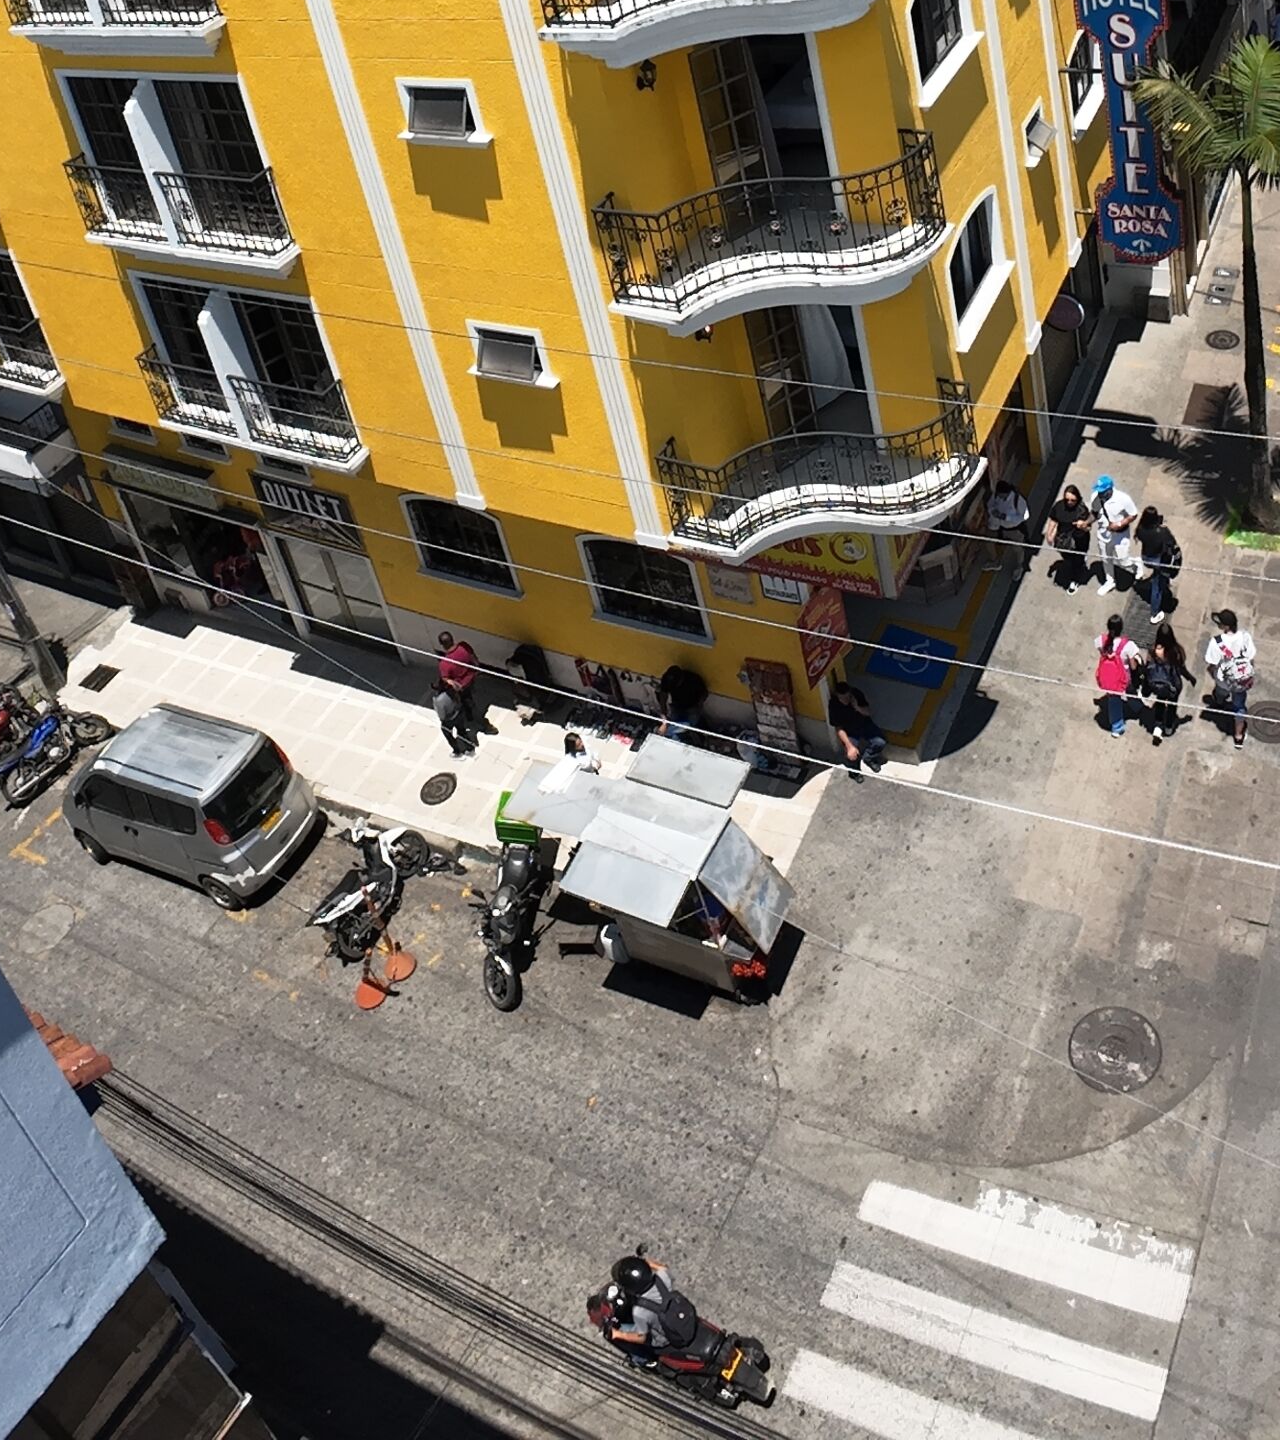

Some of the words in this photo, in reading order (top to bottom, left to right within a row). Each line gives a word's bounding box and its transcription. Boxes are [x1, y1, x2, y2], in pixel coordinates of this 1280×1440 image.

[1109, 13, 1150, 194] SUITE
[1107, 202, 1172, 222] SANTA
[1113, 219, 1169, 239] ROSA
[261, 480, 343, 521] OUTLET
